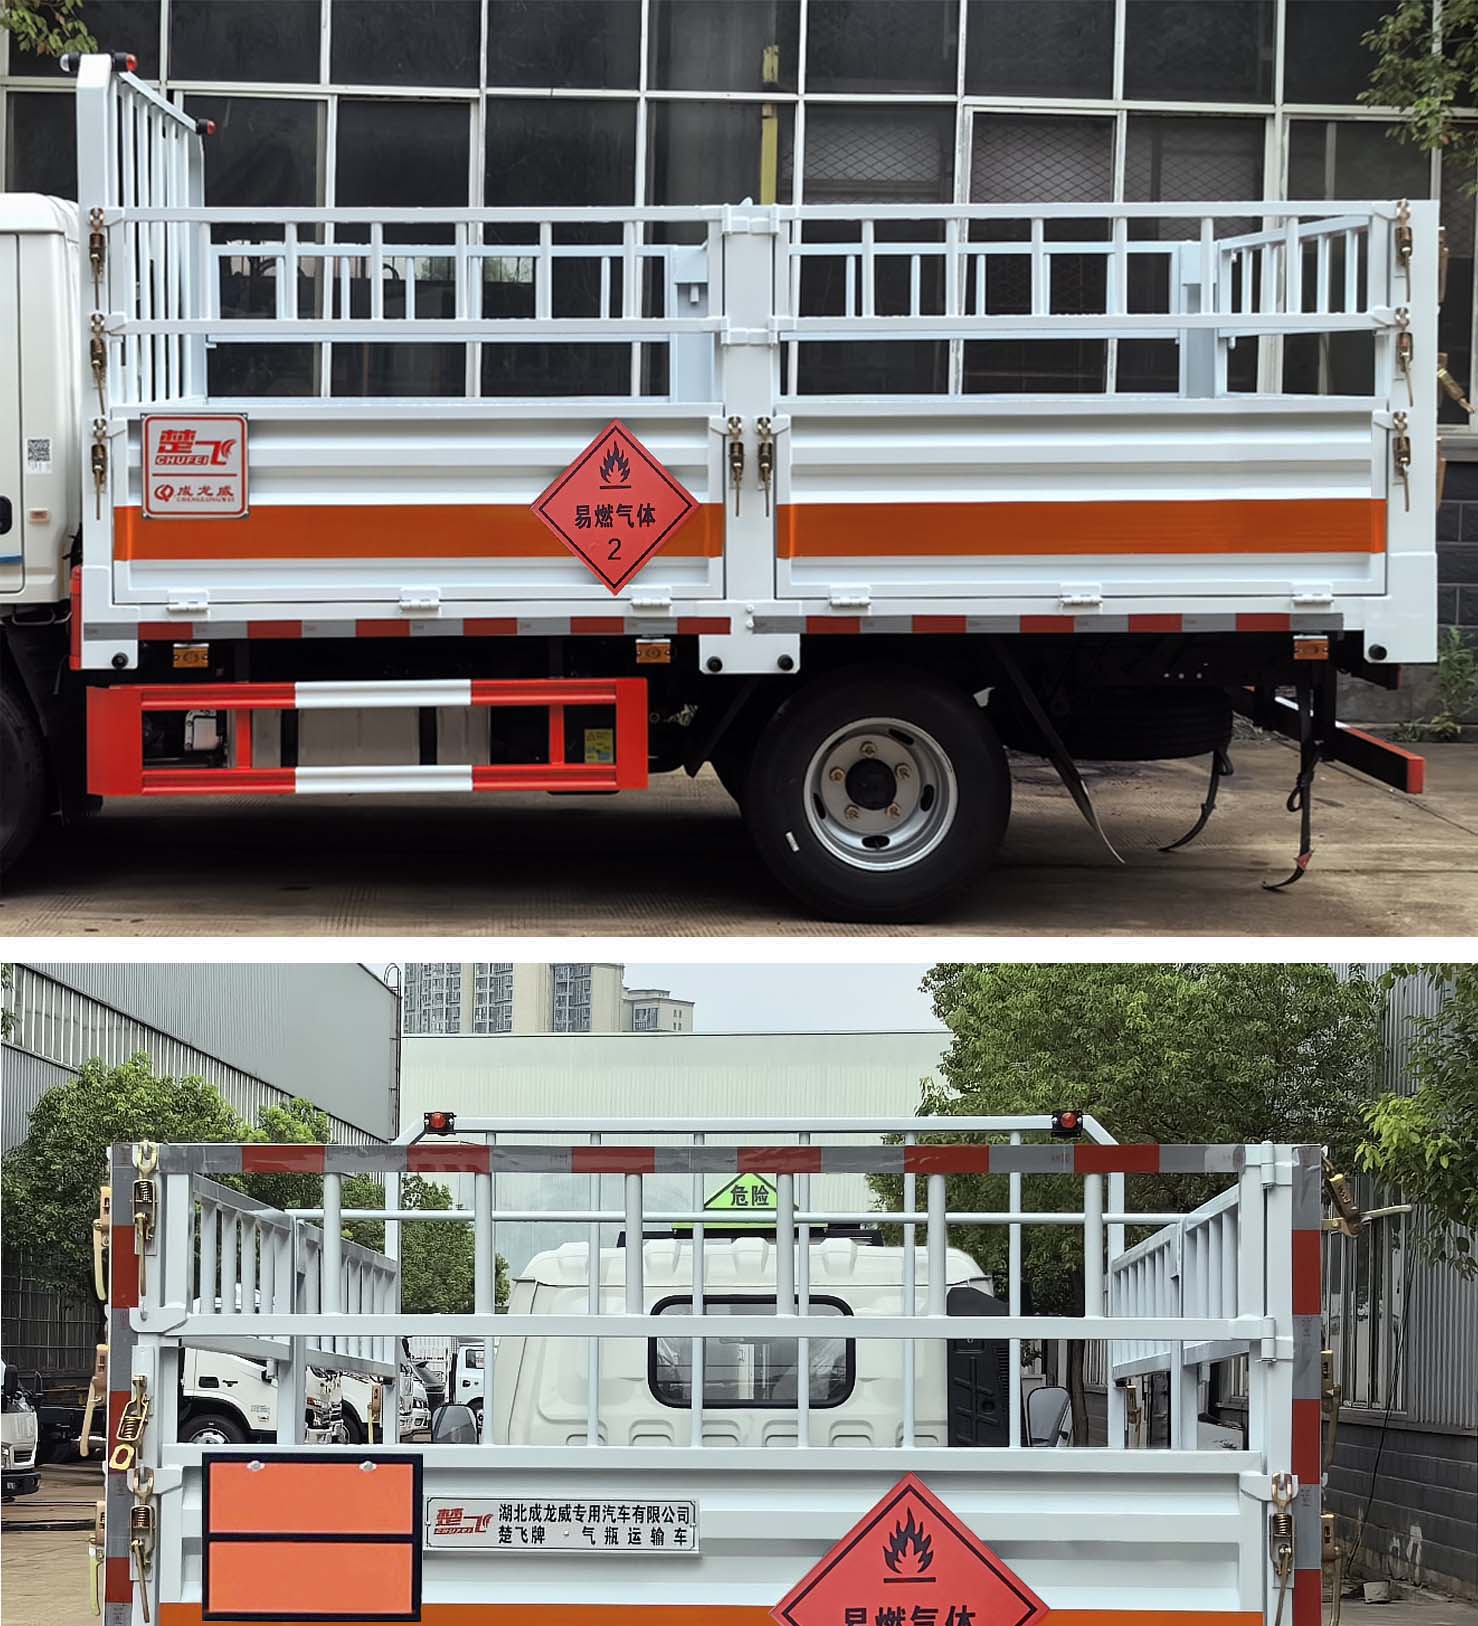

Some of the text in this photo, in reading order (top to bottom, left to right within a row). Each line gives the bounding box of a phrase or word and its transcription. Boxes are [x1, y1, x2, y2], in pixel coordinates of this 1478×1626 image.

[155, 454, 209, 465] CHUFEI
[574, 503, 656, 529] 易燃气体
[607, 537, 622, 561] 2
[730, 1184, 770, 1207] 危险
[498, 1503, 691, 1525] 湖北成龙威专用汽车有限公司
[498, 1526, 689, 1546] 楚飞牌 气瓶运输车
